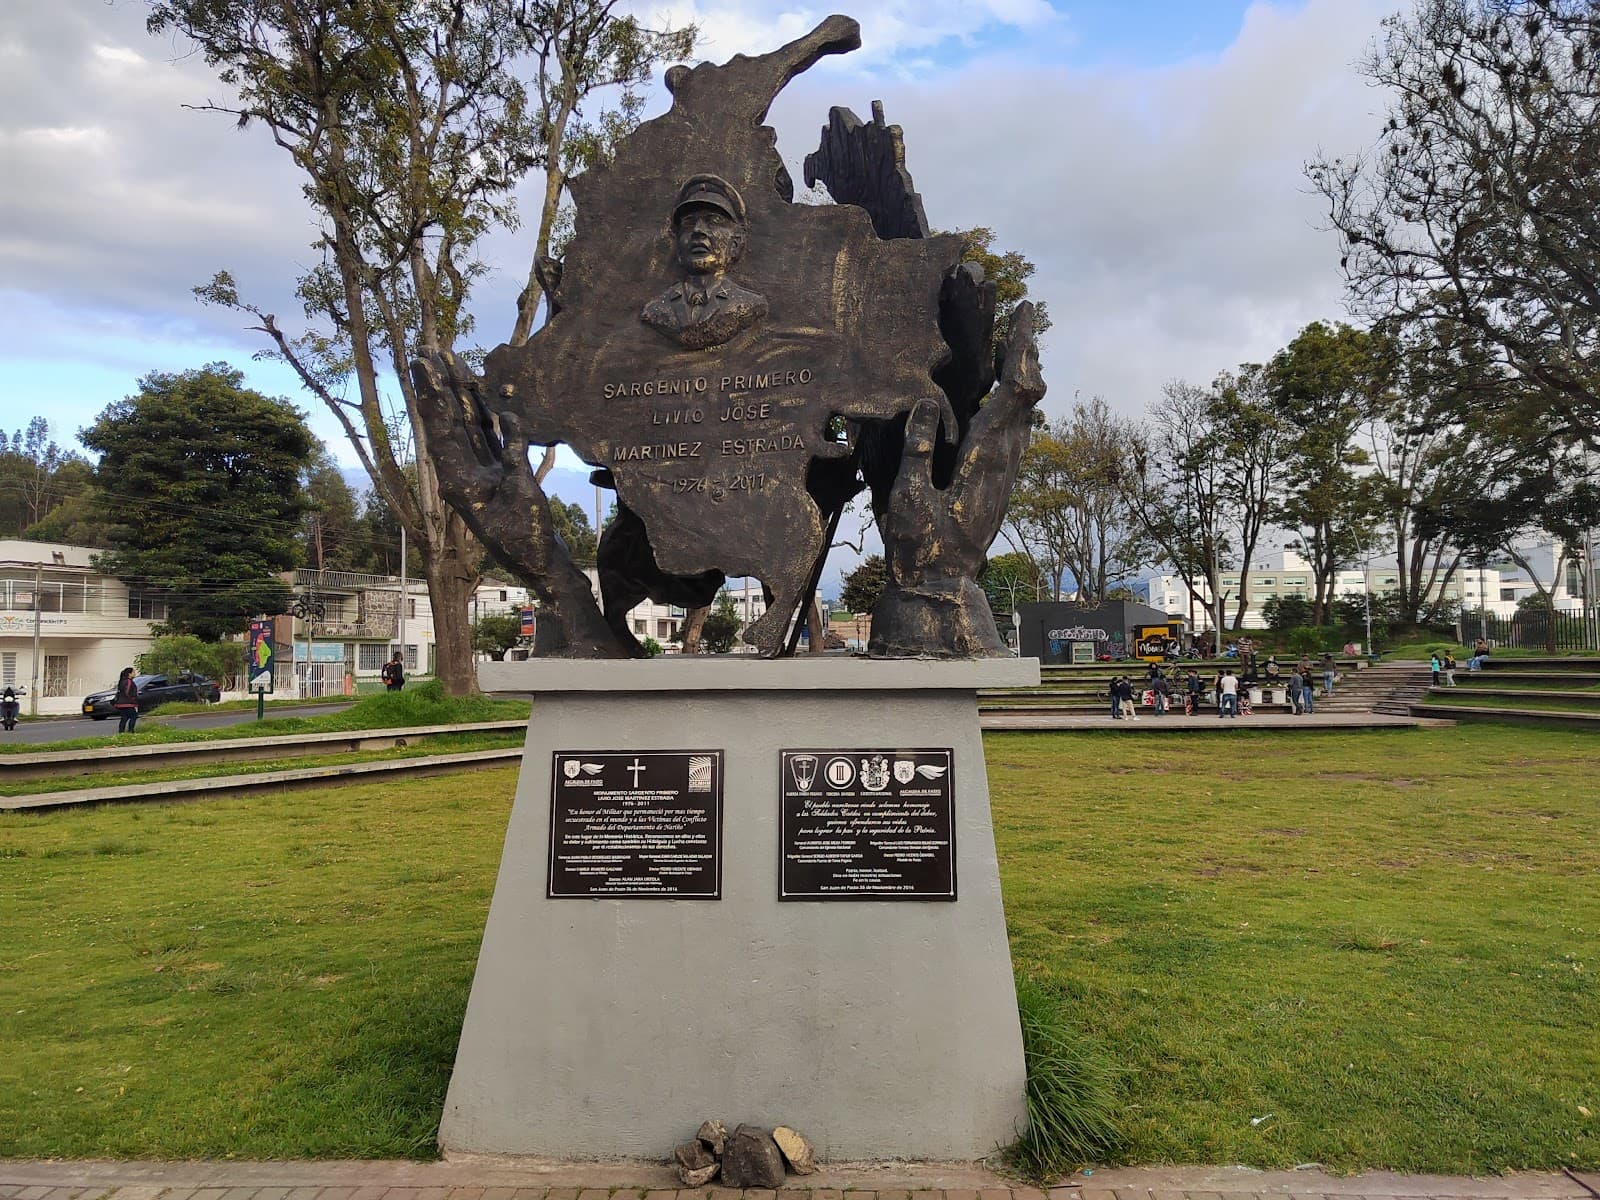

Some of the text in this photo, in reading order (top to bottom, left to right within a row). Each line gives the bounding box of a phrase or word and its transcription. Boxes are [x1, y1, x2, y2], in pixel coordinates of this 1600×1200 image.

[603, 368, 812, 400] SARGENTO PRIMERO
[653, 404, 771, 425] LIVIO JOSE
[613, 434, 805, 461] MARTINEZ ESTRADA
[671, 478, 705, 494] 1976
[729, 473, 766, 491] 2011
